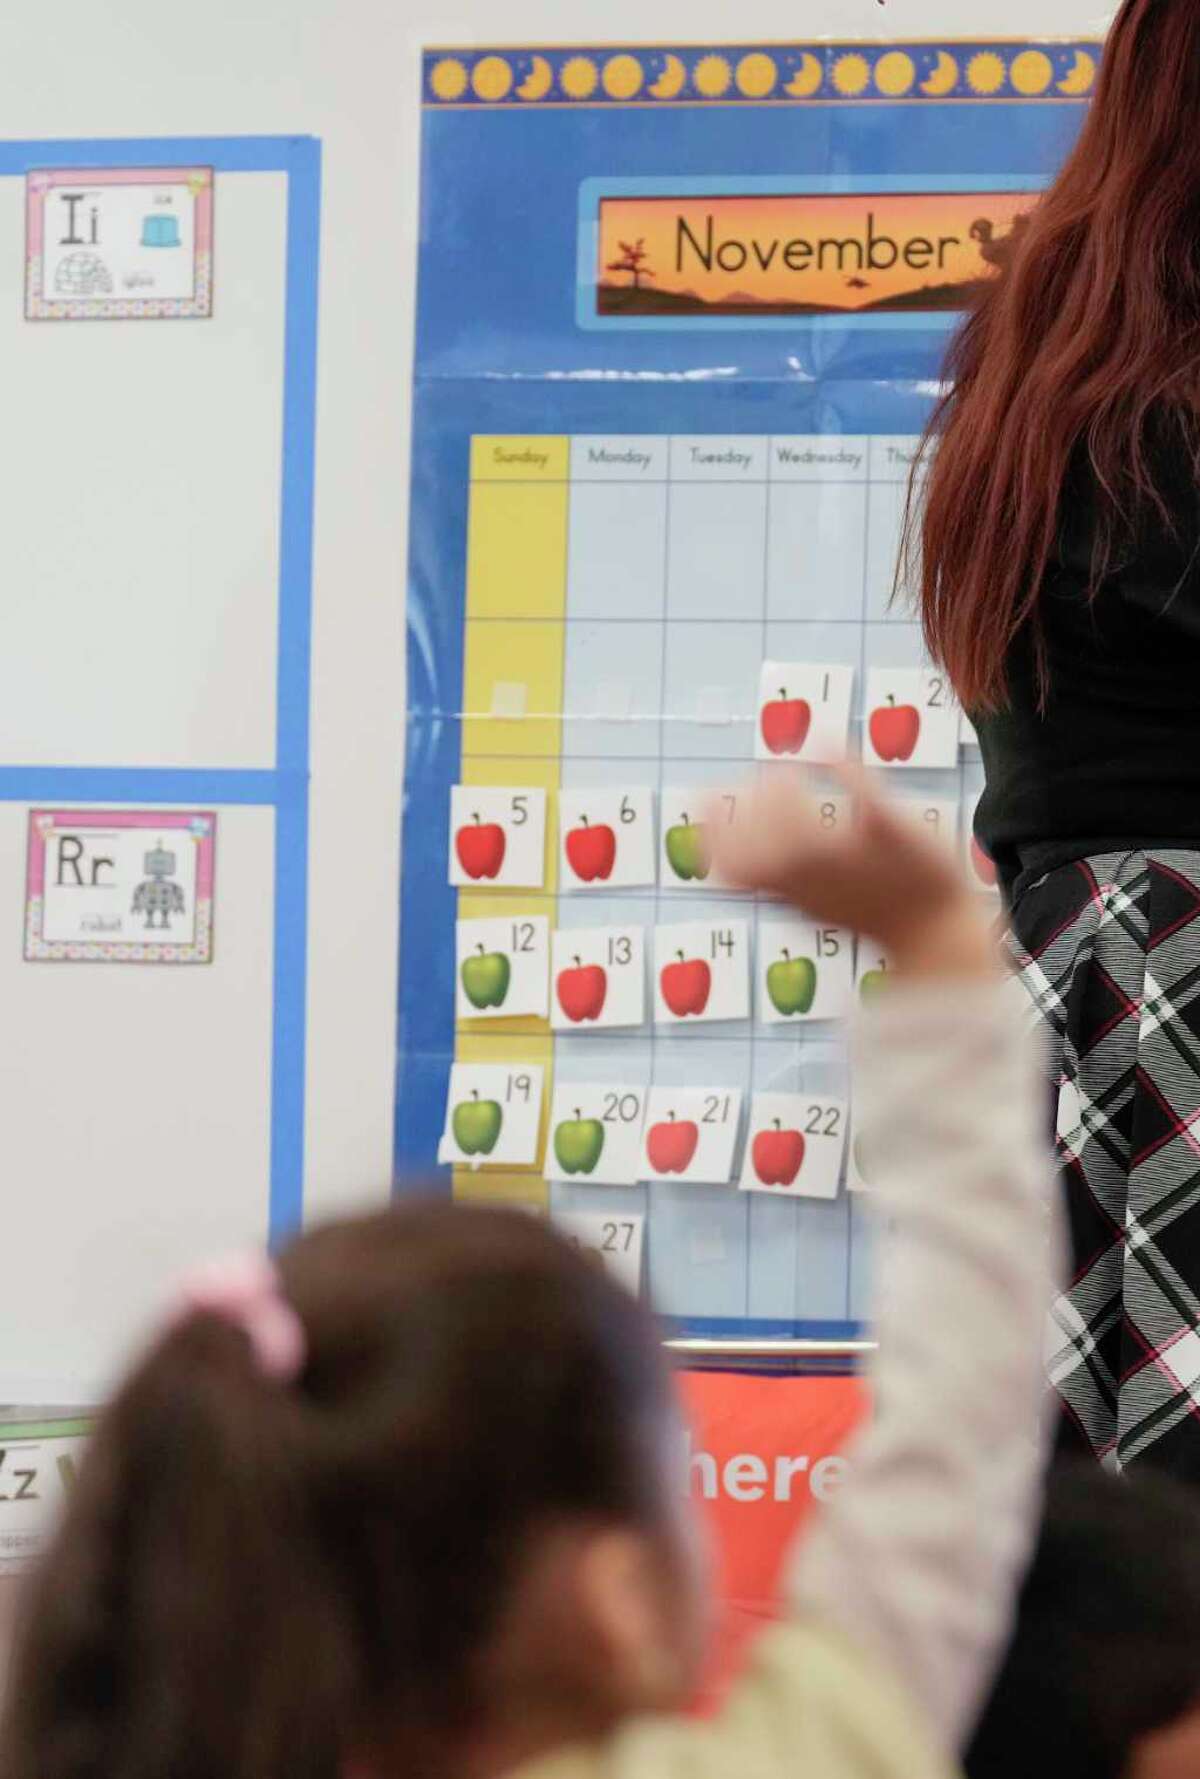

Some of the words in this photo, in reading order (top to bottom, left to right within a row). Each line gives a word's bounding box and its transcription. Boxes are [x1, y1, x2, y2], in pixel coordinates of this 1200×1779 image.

[675, 212, 961, 274] November
[492, 446, 549, 470] Sunday
[587, 446, 653, 471] Monday
[689, 446, 751, 470] Tuesday
[776, 447, 863, 470] Wednesday
[822, 672, 830, 702] 1
[927, 677, 943, 707] 2
[511, 796, 529, 825] 5
[619, 794, 637, 825] 6
[721, 794, 737, 825] 7
[819, 801, 837, 829] 8
[56, 835, 115, 886] Rr
[512, 922, 536, 952] 12
[608, 936, 633, 966] 13
[711, 929, 735, 959] 14
[815, 929, 840, 957] 15
[506, 1073, 532, 1103] 19
[601, 1092, 640, 1123] 20
[701, 1094, 731, 1124] 21
[803, 1105, 841, 1137] 22
[601, 1222, 636, 1252] 27
